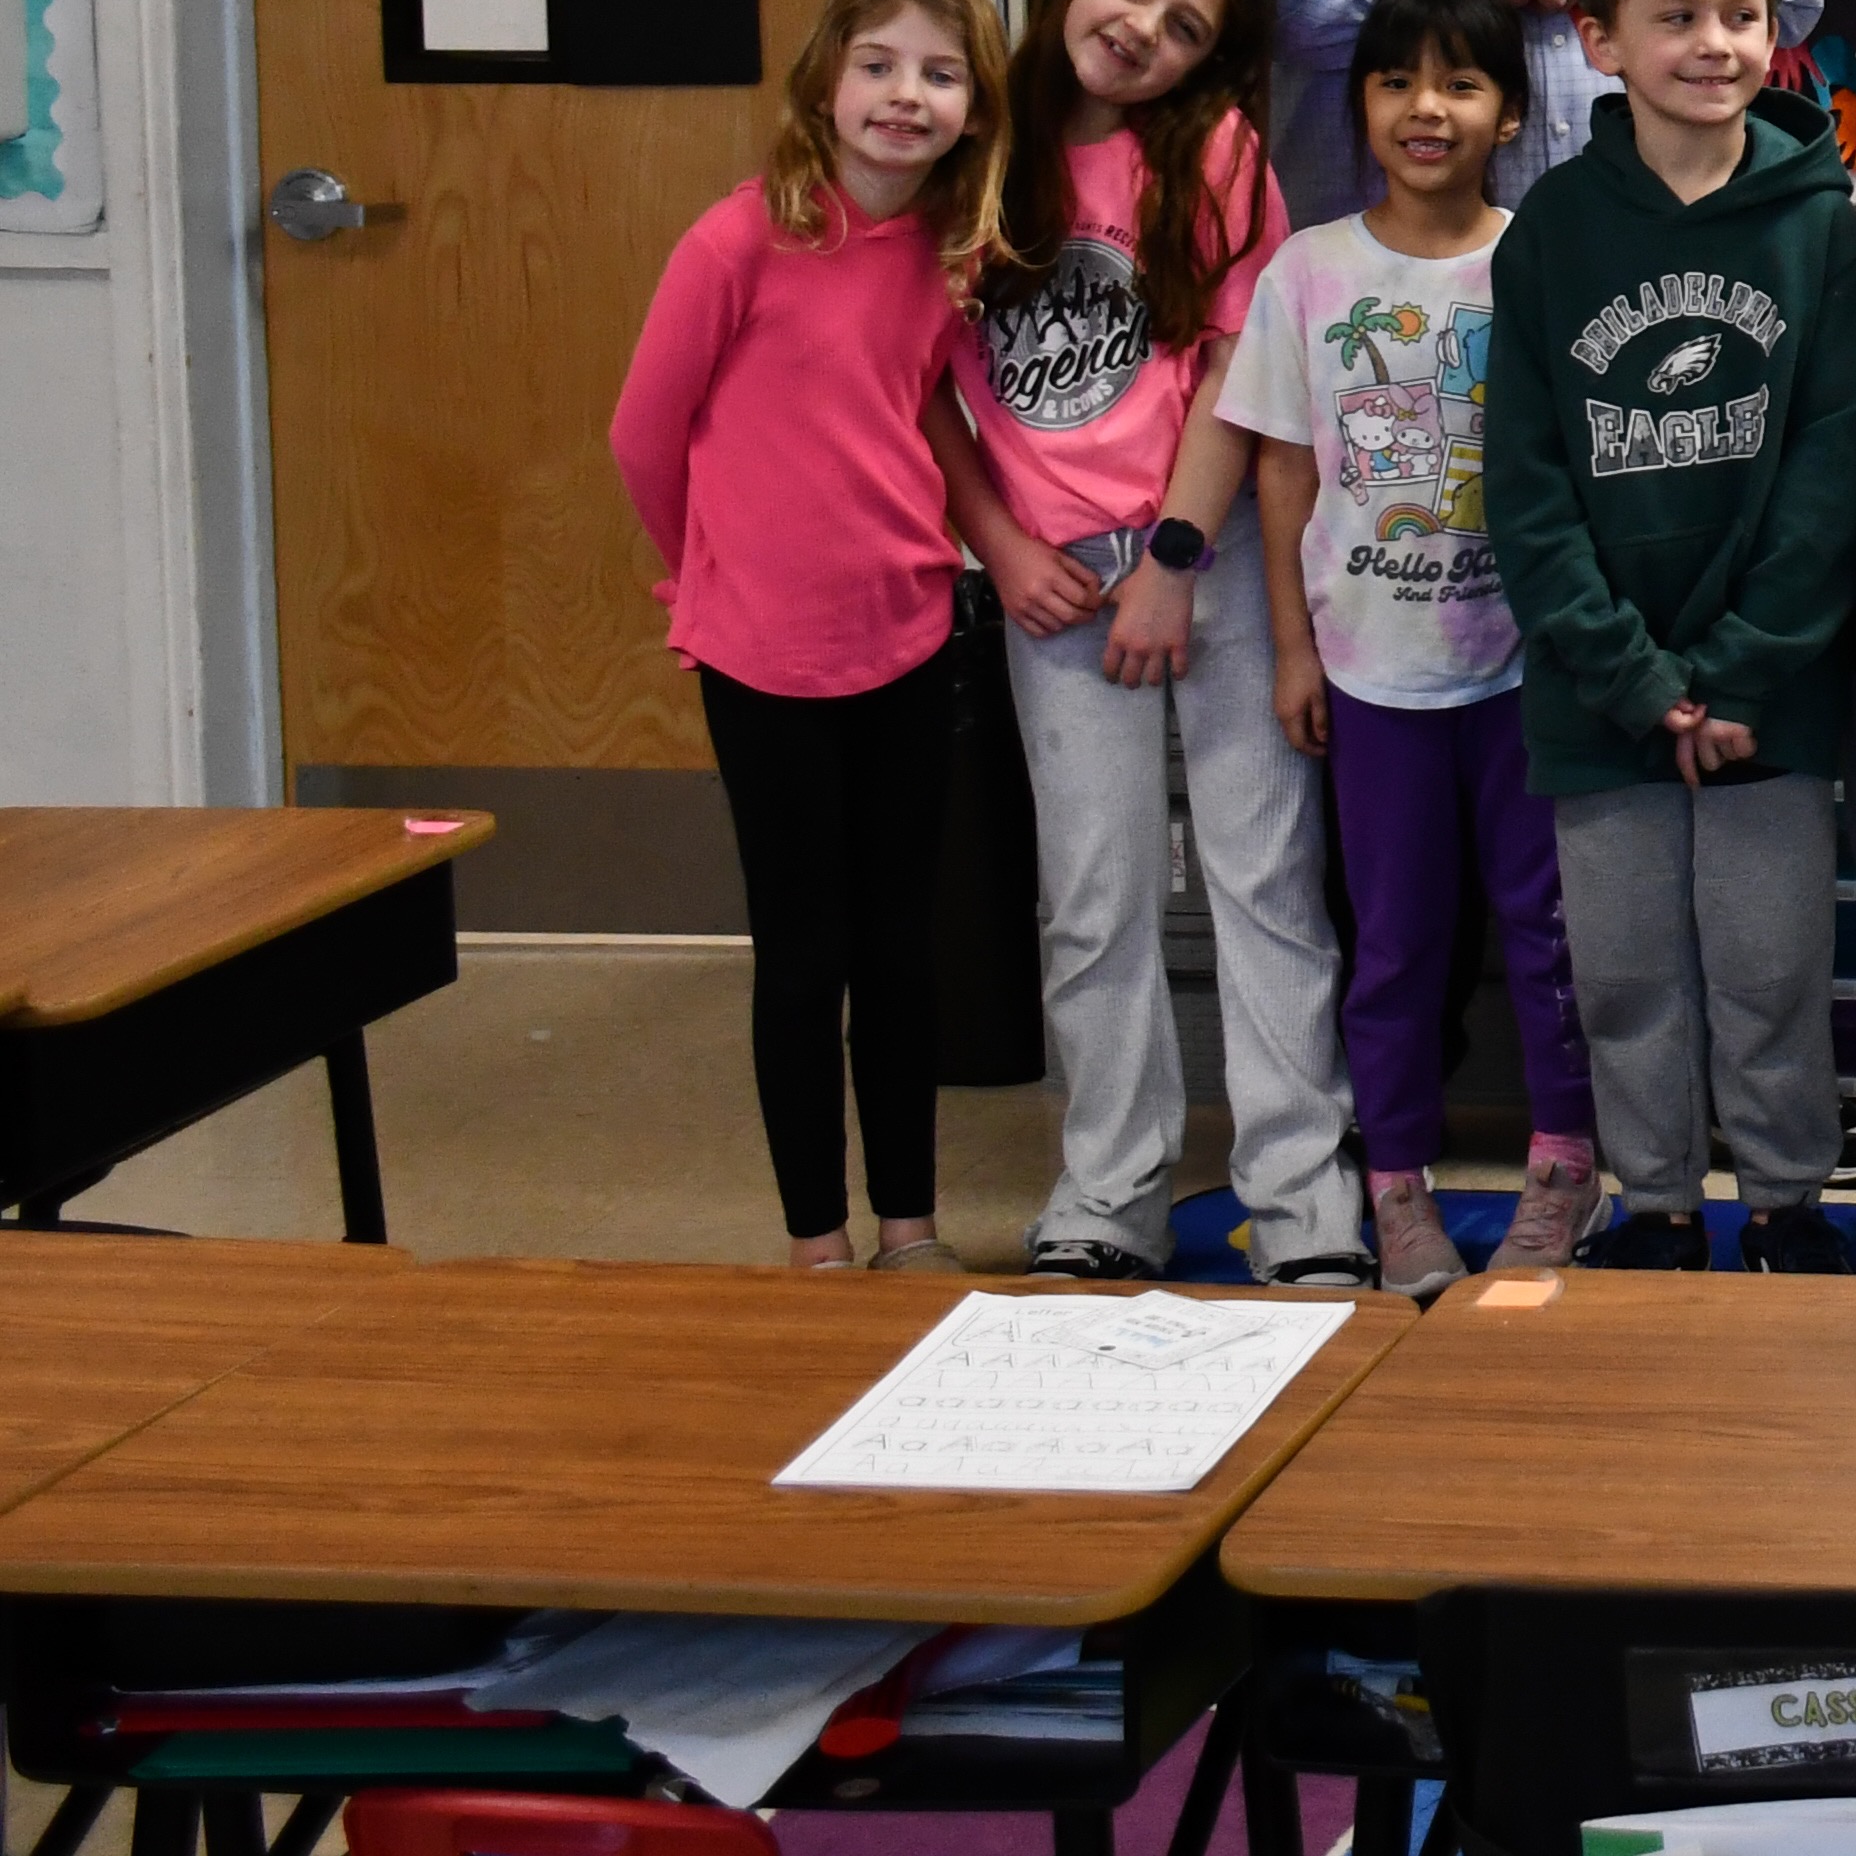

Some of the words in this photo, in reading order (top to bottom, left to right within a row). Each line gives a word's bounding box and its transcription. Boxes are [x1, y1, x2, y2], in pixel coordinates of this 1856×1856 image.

[1571, 272, 1786, 375] PHILADELPHI
[1042, 399, 1057, 419] &
[1062, 378, 1114, 417] ICONS
[1586, 383, 1770, 476] EAGLE
[1347, 545, 1443, 582] Hello
